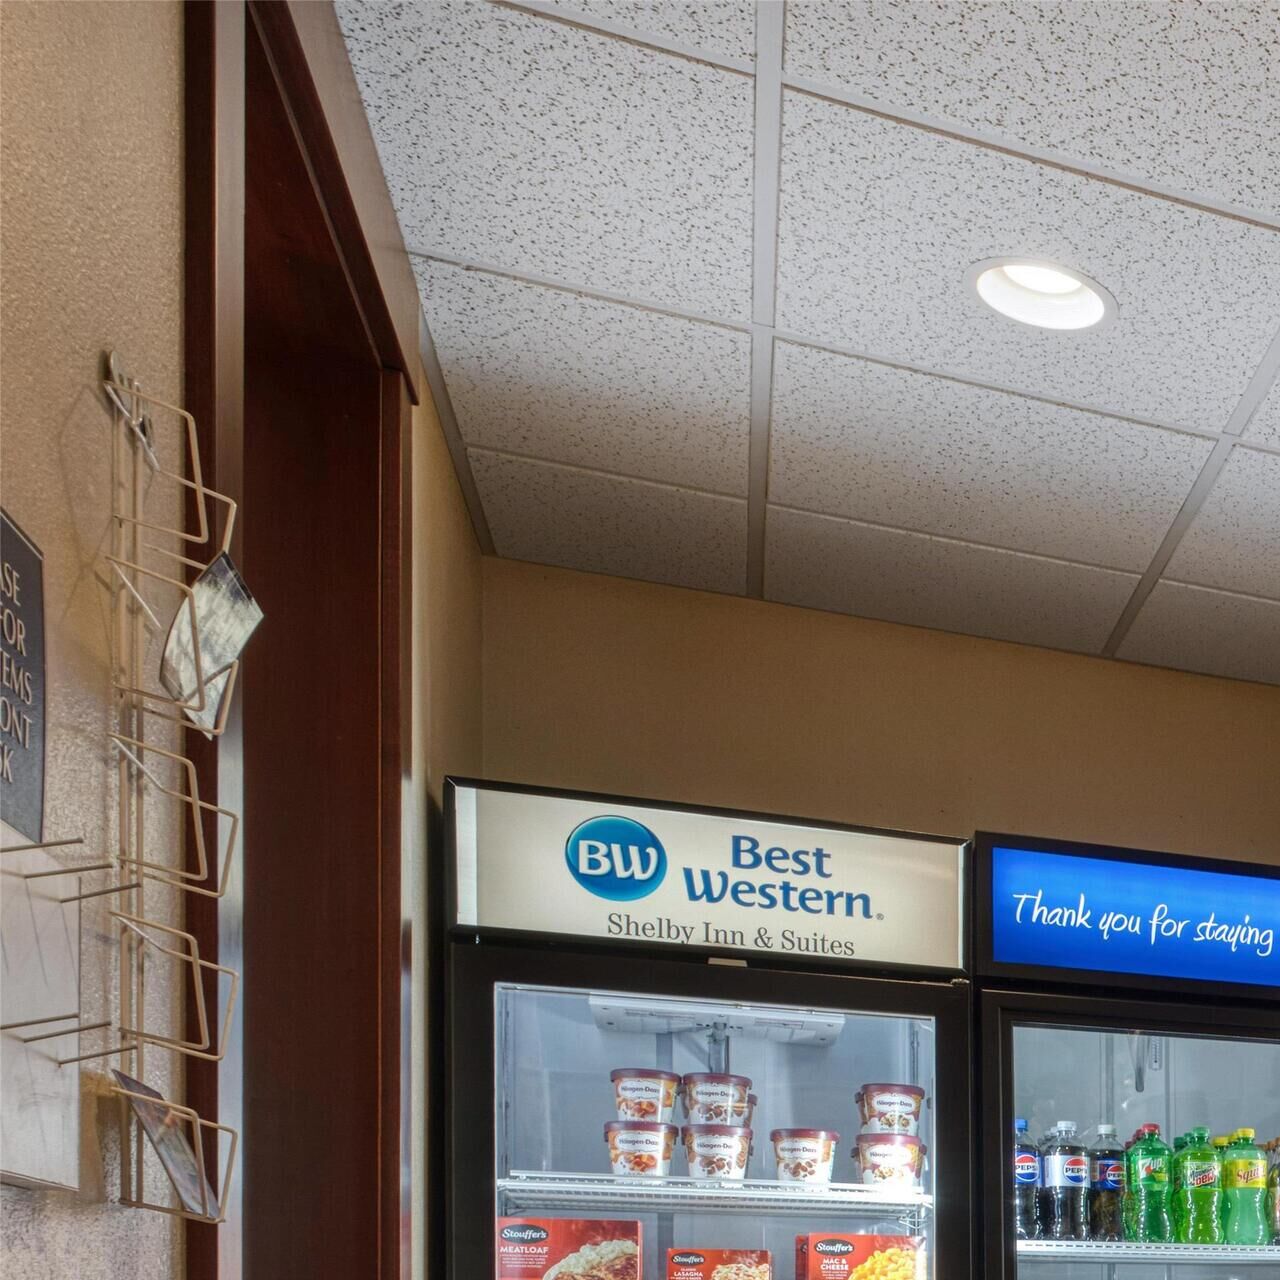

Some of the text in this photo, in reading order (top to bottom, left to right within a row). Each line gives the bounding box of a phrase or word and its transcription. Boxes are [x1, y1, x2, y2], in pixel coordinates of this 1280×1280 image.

[577, 838, 659, 882] BW
[731, 834, 833, 879] Best
[682, 866, 874, 920] Western
[606, 912, 856, 957] Shelby Inn & Suites
[1012, 889, 1093, 929] Thank
[1098, 911, 1142, 941] you
[1149, 904, 1191, 946] for
[1193, 912, 1274, 957] staying
[1016, 1164, 1038, 1172] PEPS
[501, 1224, 548, 1240] Stouffer's
[499, 1246, 549, 1255] MEATLOAF
[671, 1254, 705, 1265] Stouffer's
[815, 1241, 854, 1254] Stouffer's
